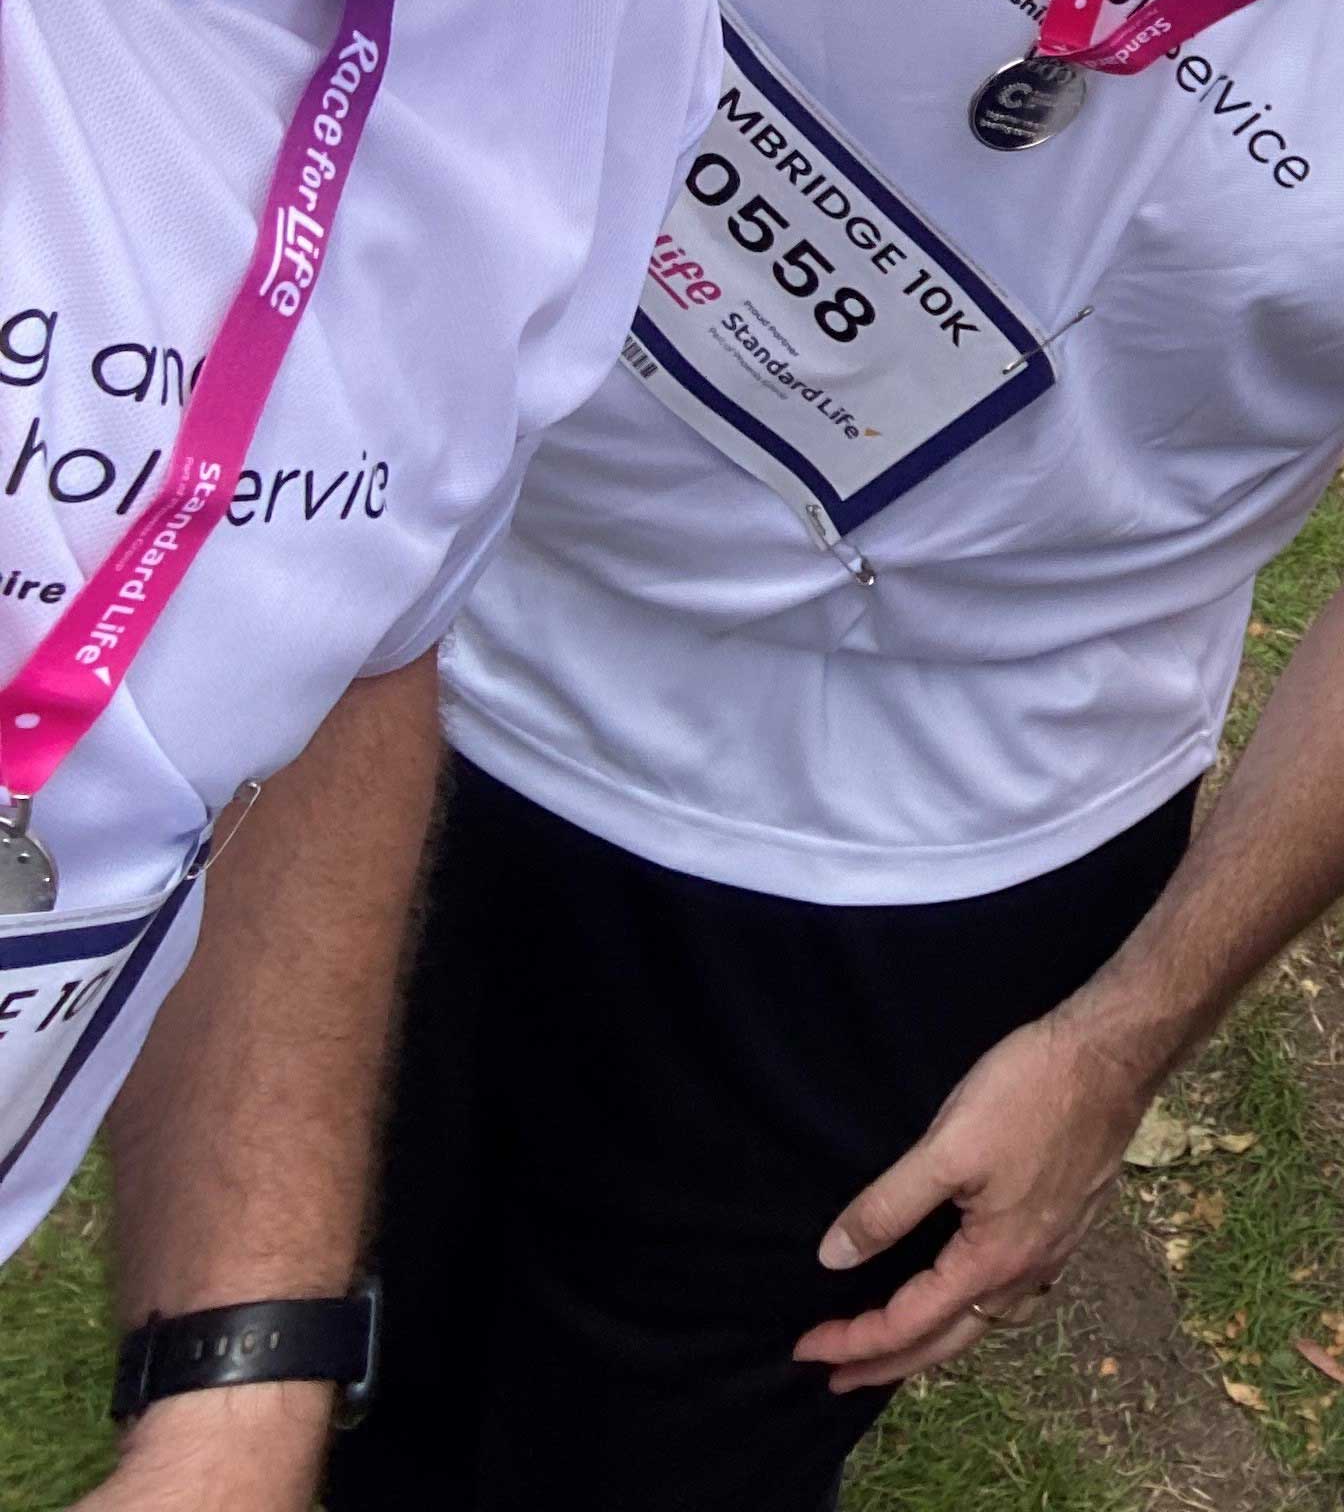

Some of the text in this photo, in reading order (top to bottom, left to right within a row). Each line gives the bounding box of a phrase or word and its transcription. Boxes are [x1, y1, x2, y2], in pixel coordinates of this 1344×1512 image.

[268, 29, 378, 317] Race for Life
[1165, 42, 1311, 188] ervice
[92, 342, 206, 408] an
[721, 312, 860, 440] Standard Life
[902, 269, 981, 348] 10K
[75, 461, 221, 666] Standard Life
